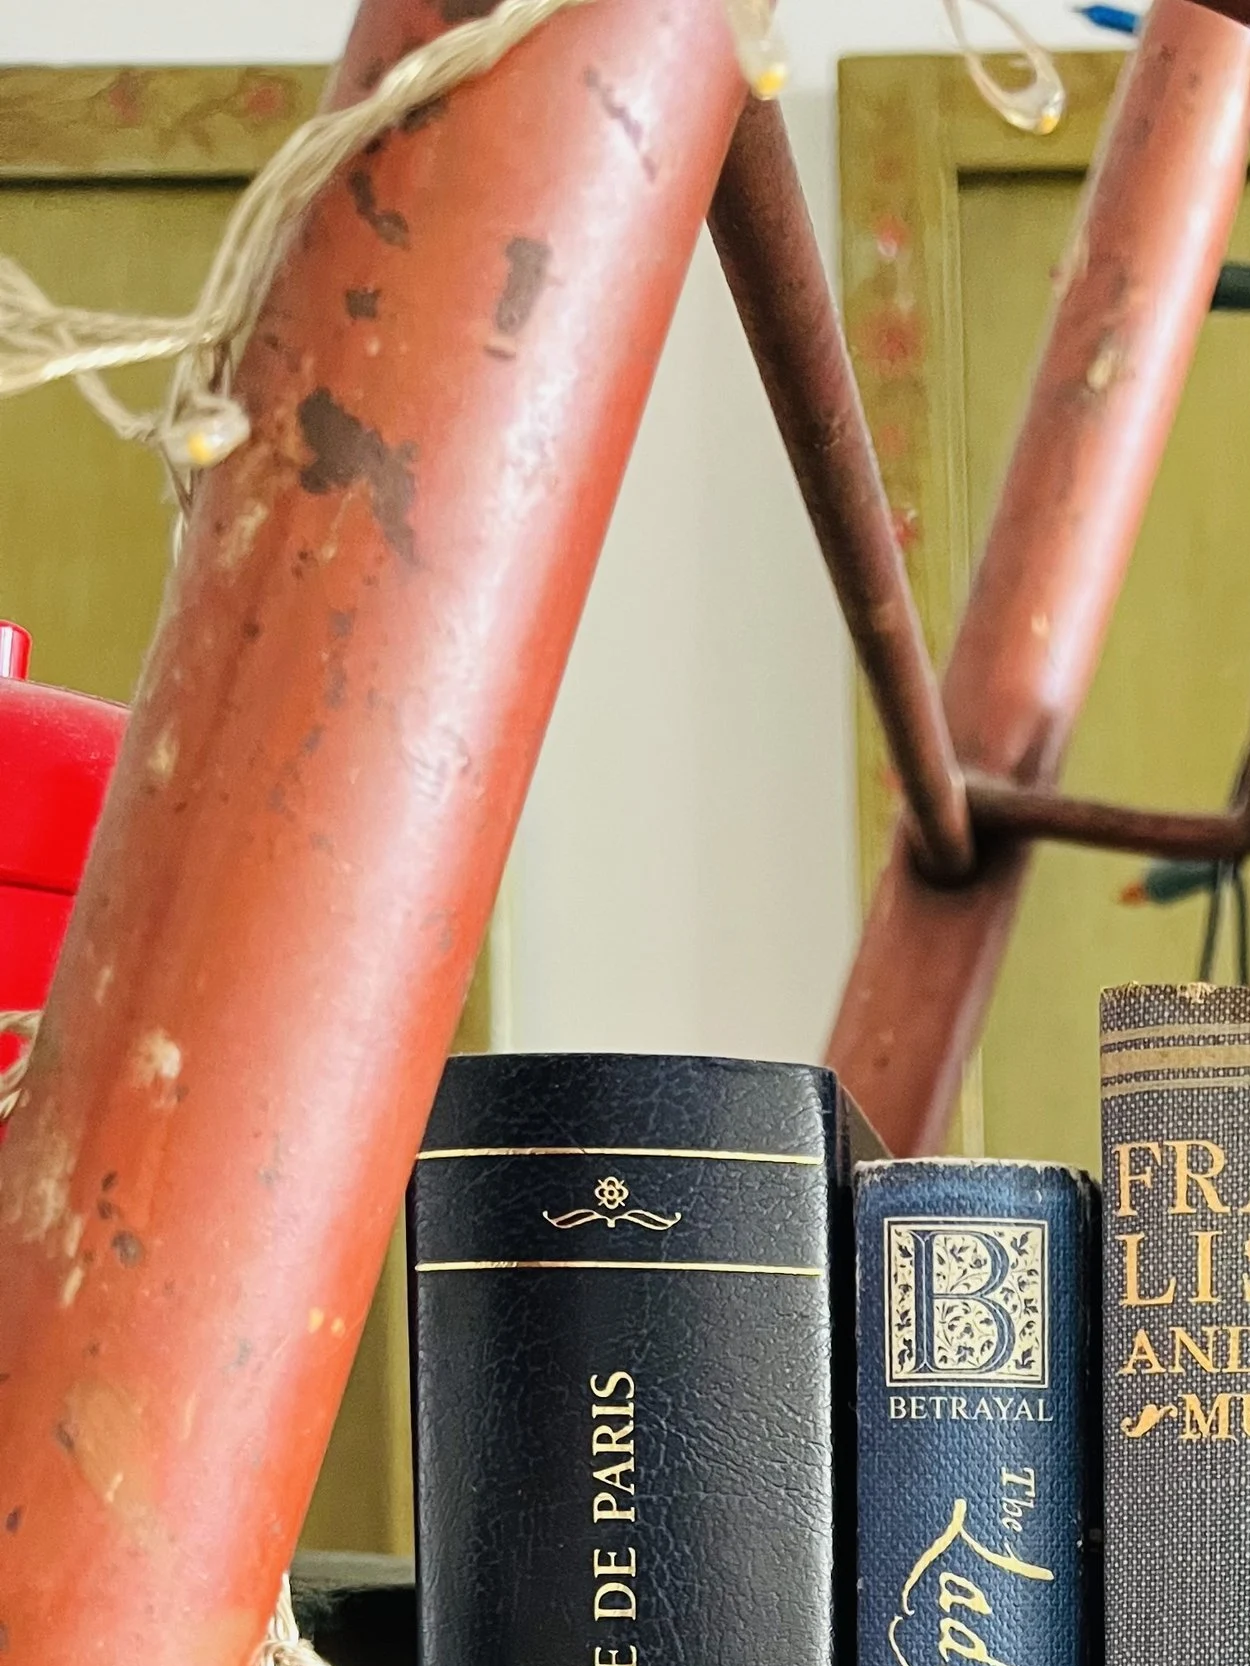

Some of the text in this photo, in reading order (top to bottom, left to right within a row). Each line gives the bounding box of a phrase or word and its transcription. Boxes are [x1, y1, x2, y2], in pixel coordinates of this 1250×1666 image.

[889, 1396, 1054, 1422] BETRAYAL
[590, 1370, 637, 1523] PARIS
[1000, 1466, 1036, 1533] The
[593, 1546, 638, 1621] DE
